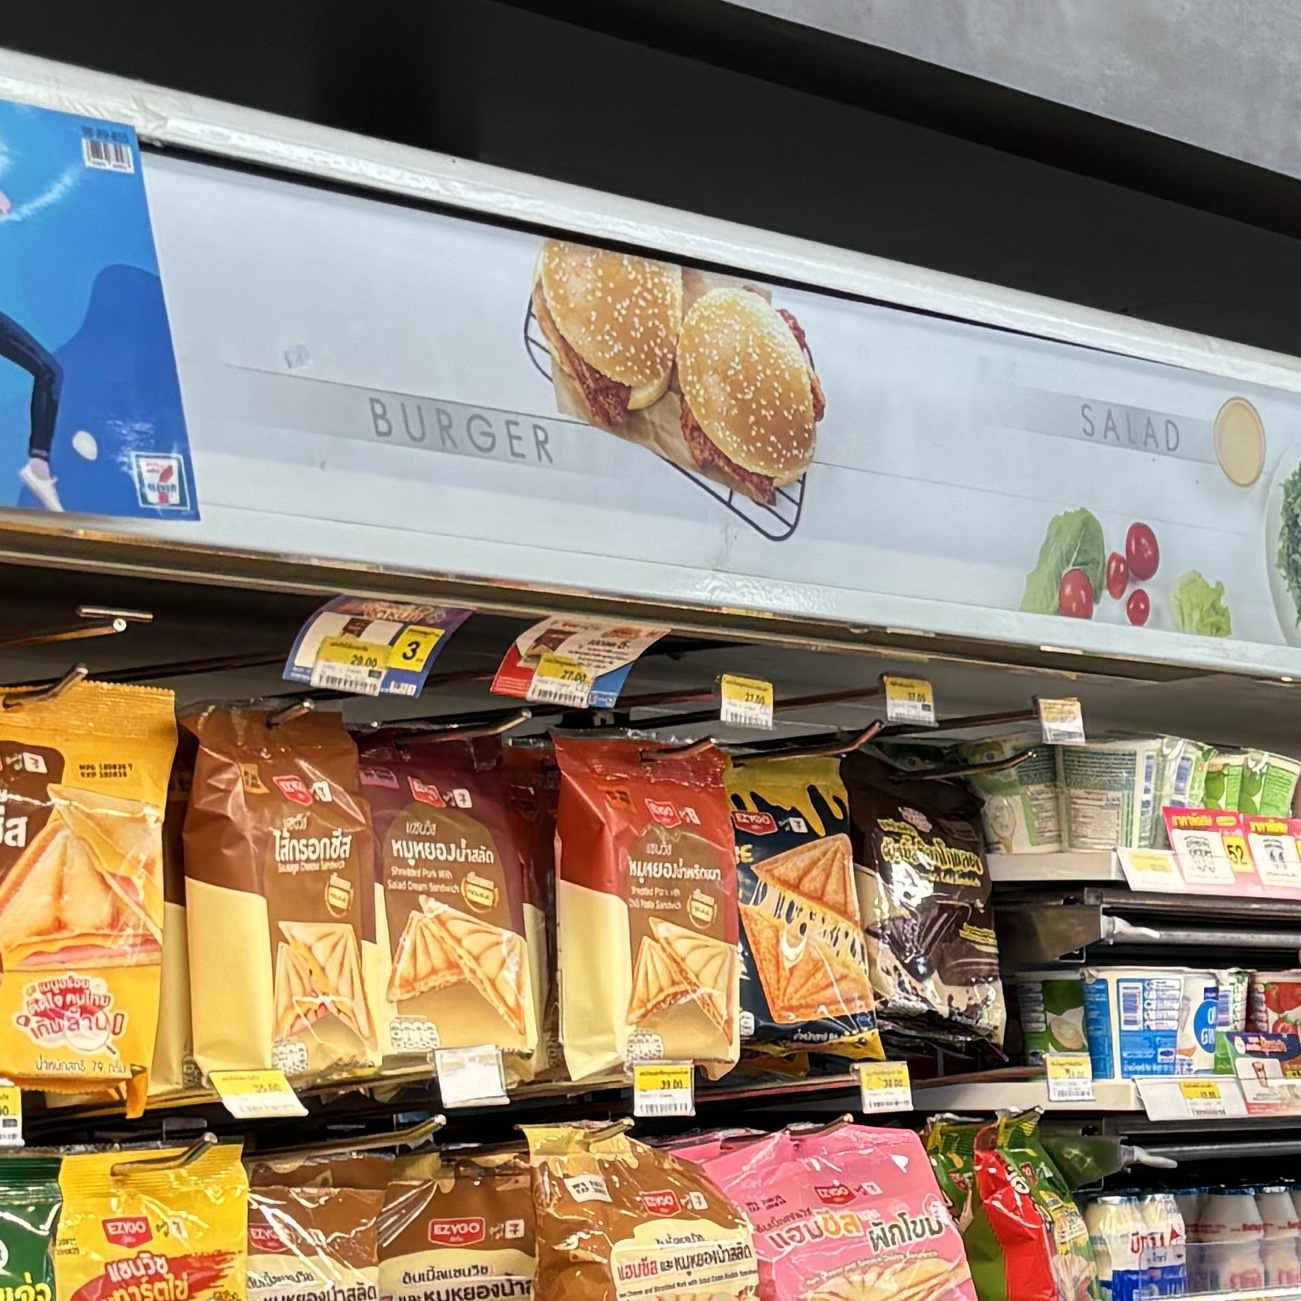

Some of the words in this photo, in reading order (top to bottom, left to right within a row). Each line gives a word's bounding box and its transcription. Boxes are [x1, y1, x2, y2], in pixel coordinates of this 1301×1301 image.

[370, 397, 555, 464] BURGER
[1081, 403, 1180, 452] SALAD
[401, 641, 420, 661] 3
[273, 827, 352, 861] ไส้กรอกชีส
[392, 839, 494, 865] หมูหยองน้ำสลัด
[106, 1223, 146, 1235] EZYGO
[433, 1222, 480, 1235] EZYGO
[107, 1253, 168, 1282] แซนวิช
